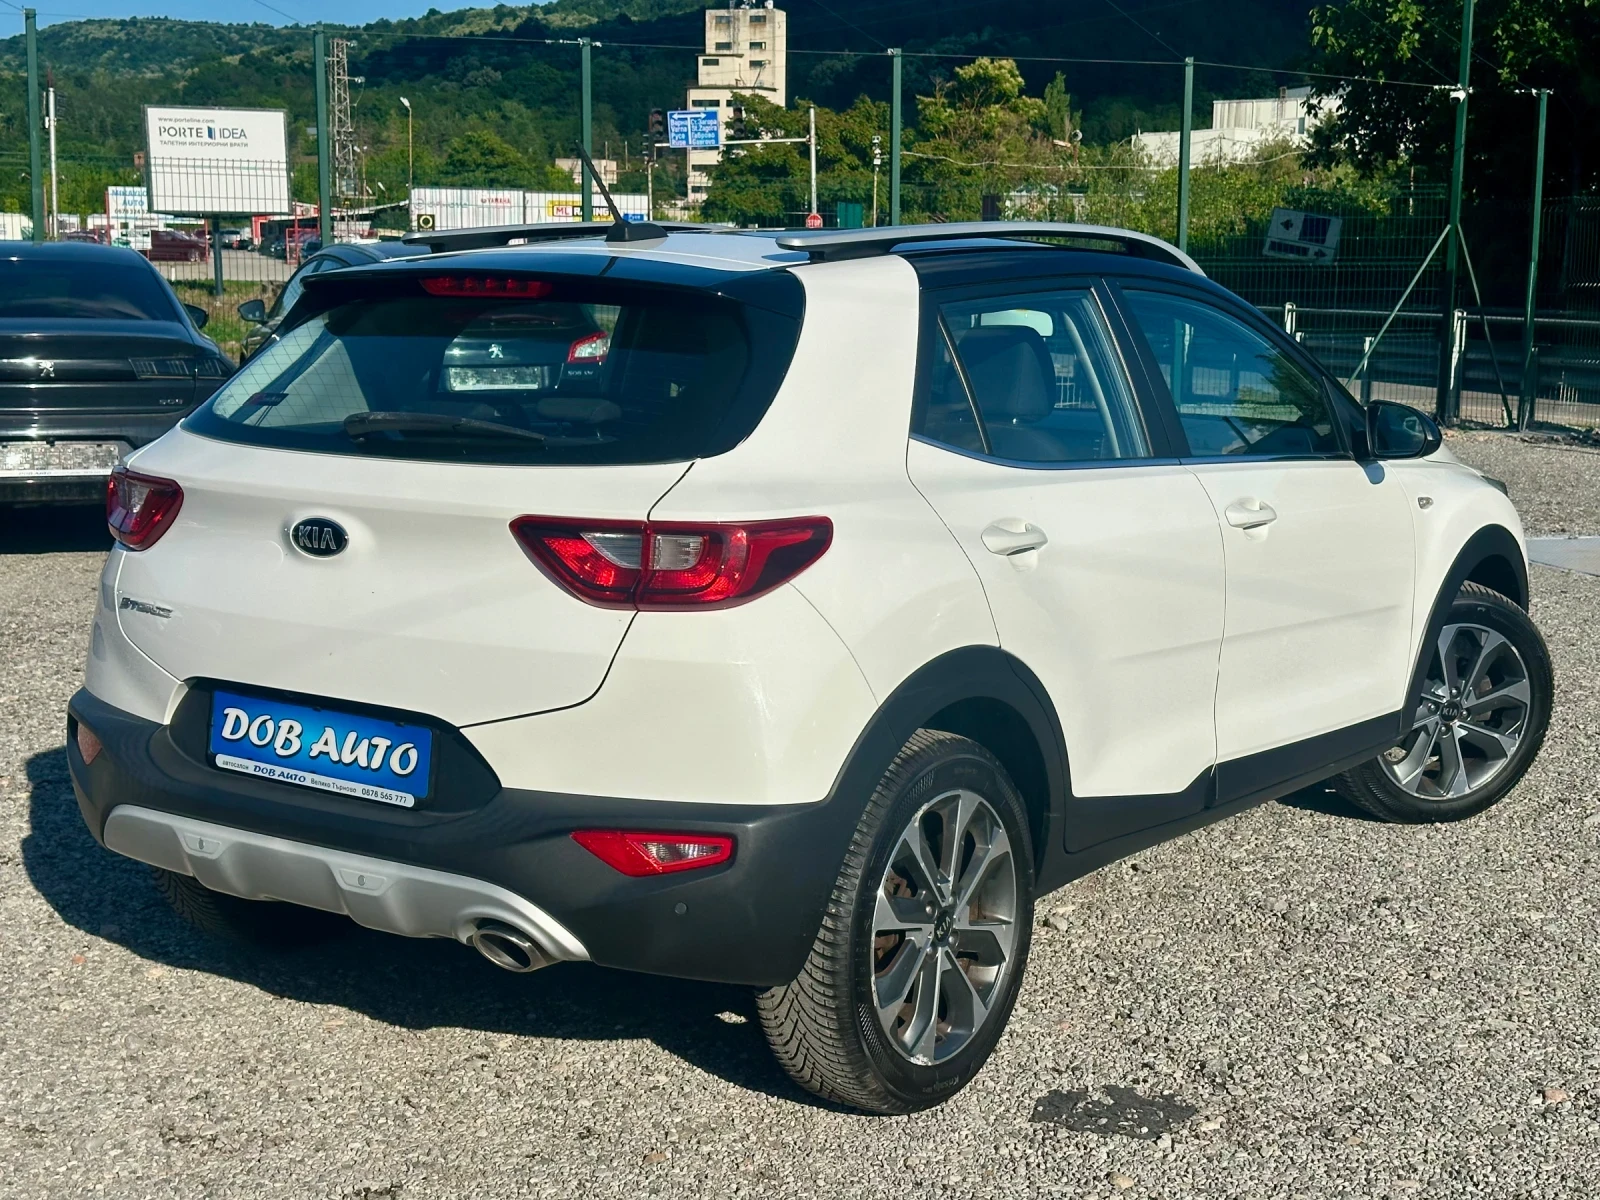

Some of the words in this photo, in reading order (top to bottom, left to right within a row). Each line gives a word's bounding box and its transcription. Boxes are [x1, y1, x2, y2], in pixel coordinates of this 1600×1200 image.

[158, 126, 203, 138] PORTE
[219, 128, 248, 139] IDEA
[555, 206, 570, 215] ML
[807, 219, 821, 227] STOP
[299, 525, 337, 549] KIA
[1442, 707, 1458, 716] KIA
[221, 707, 303, 756] DOB
[309, 727, 418, 775] AUTO
[222, 760, 249, 770] автосалон
[253, 765, 276, 777] DOB
[278, 771, 306, 783] AUTO
[310, 777, 331, 788] Велико
[332, 782, 357, 794] Търново
[361, 788, 379, 798] 0878
[380, 792, 393, 801] 565
[395, 795, 407, 804] 777
[936, 916, 951, 938] KIA
